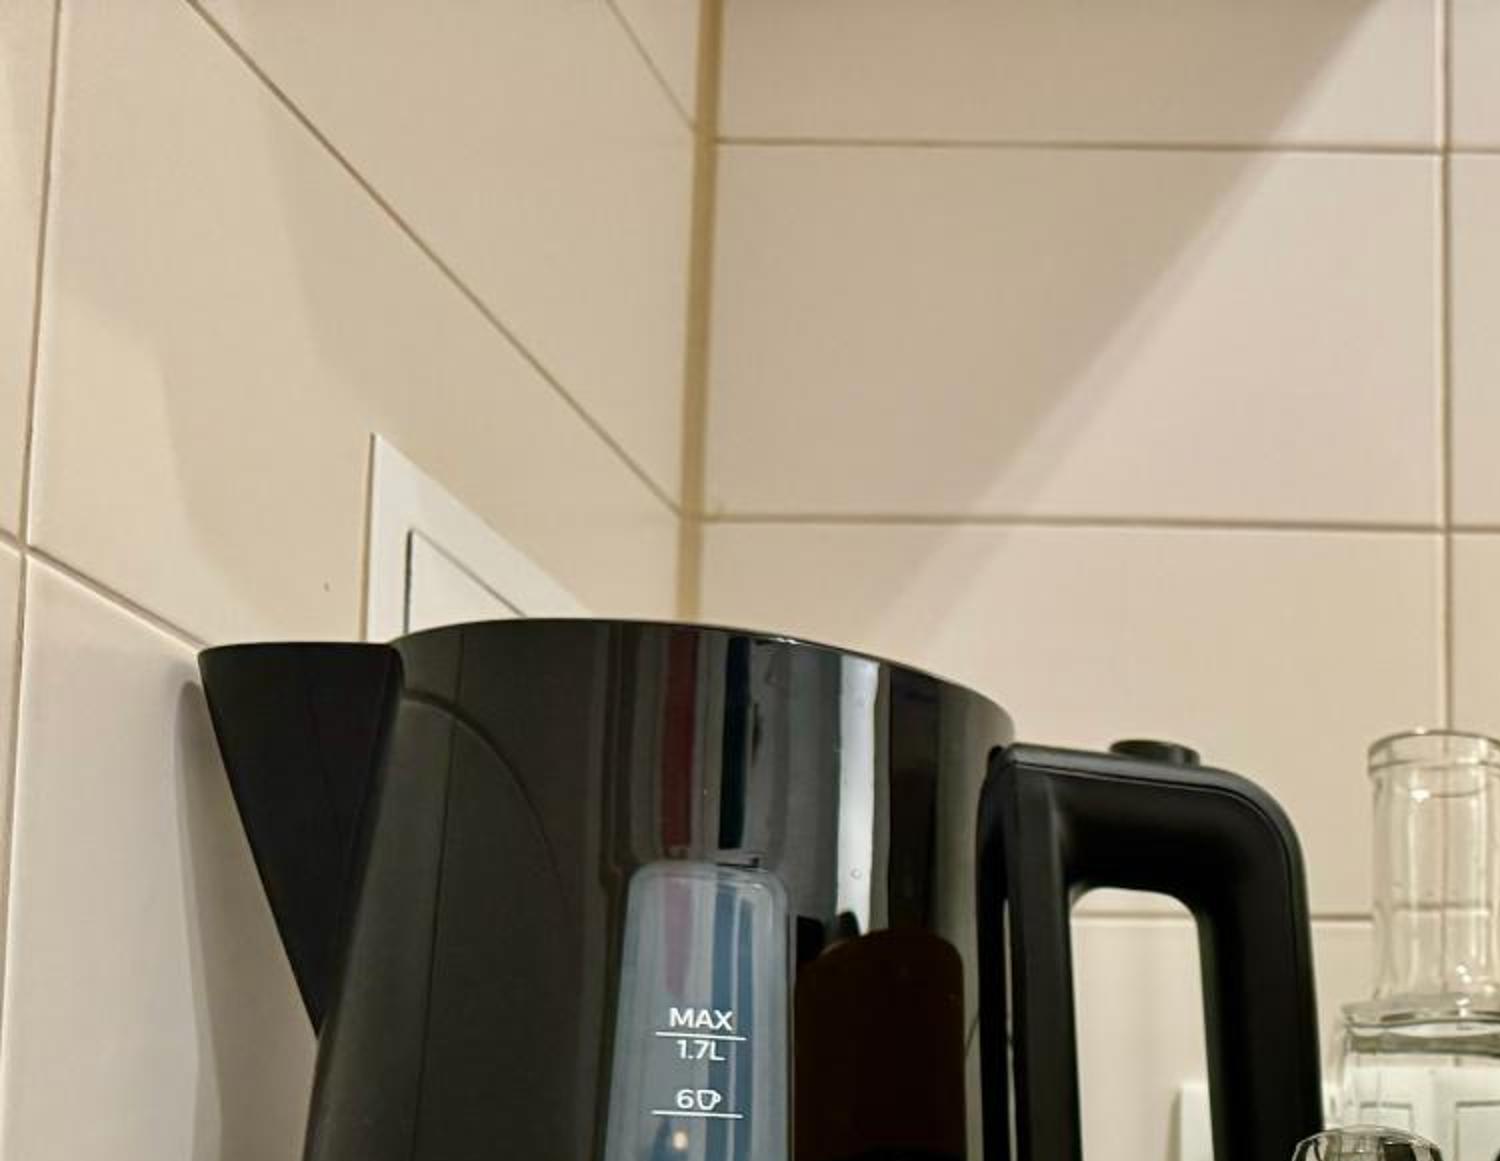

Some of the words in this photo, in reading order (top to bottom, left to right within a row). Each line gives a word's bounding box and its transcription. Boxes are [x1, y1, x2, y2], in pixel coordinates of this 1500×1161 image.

[668, 1007, 734, 1031] MAX
[676, 1040, 726, 1061] 1.7L
[676, 1089, 694, 1109] 6
